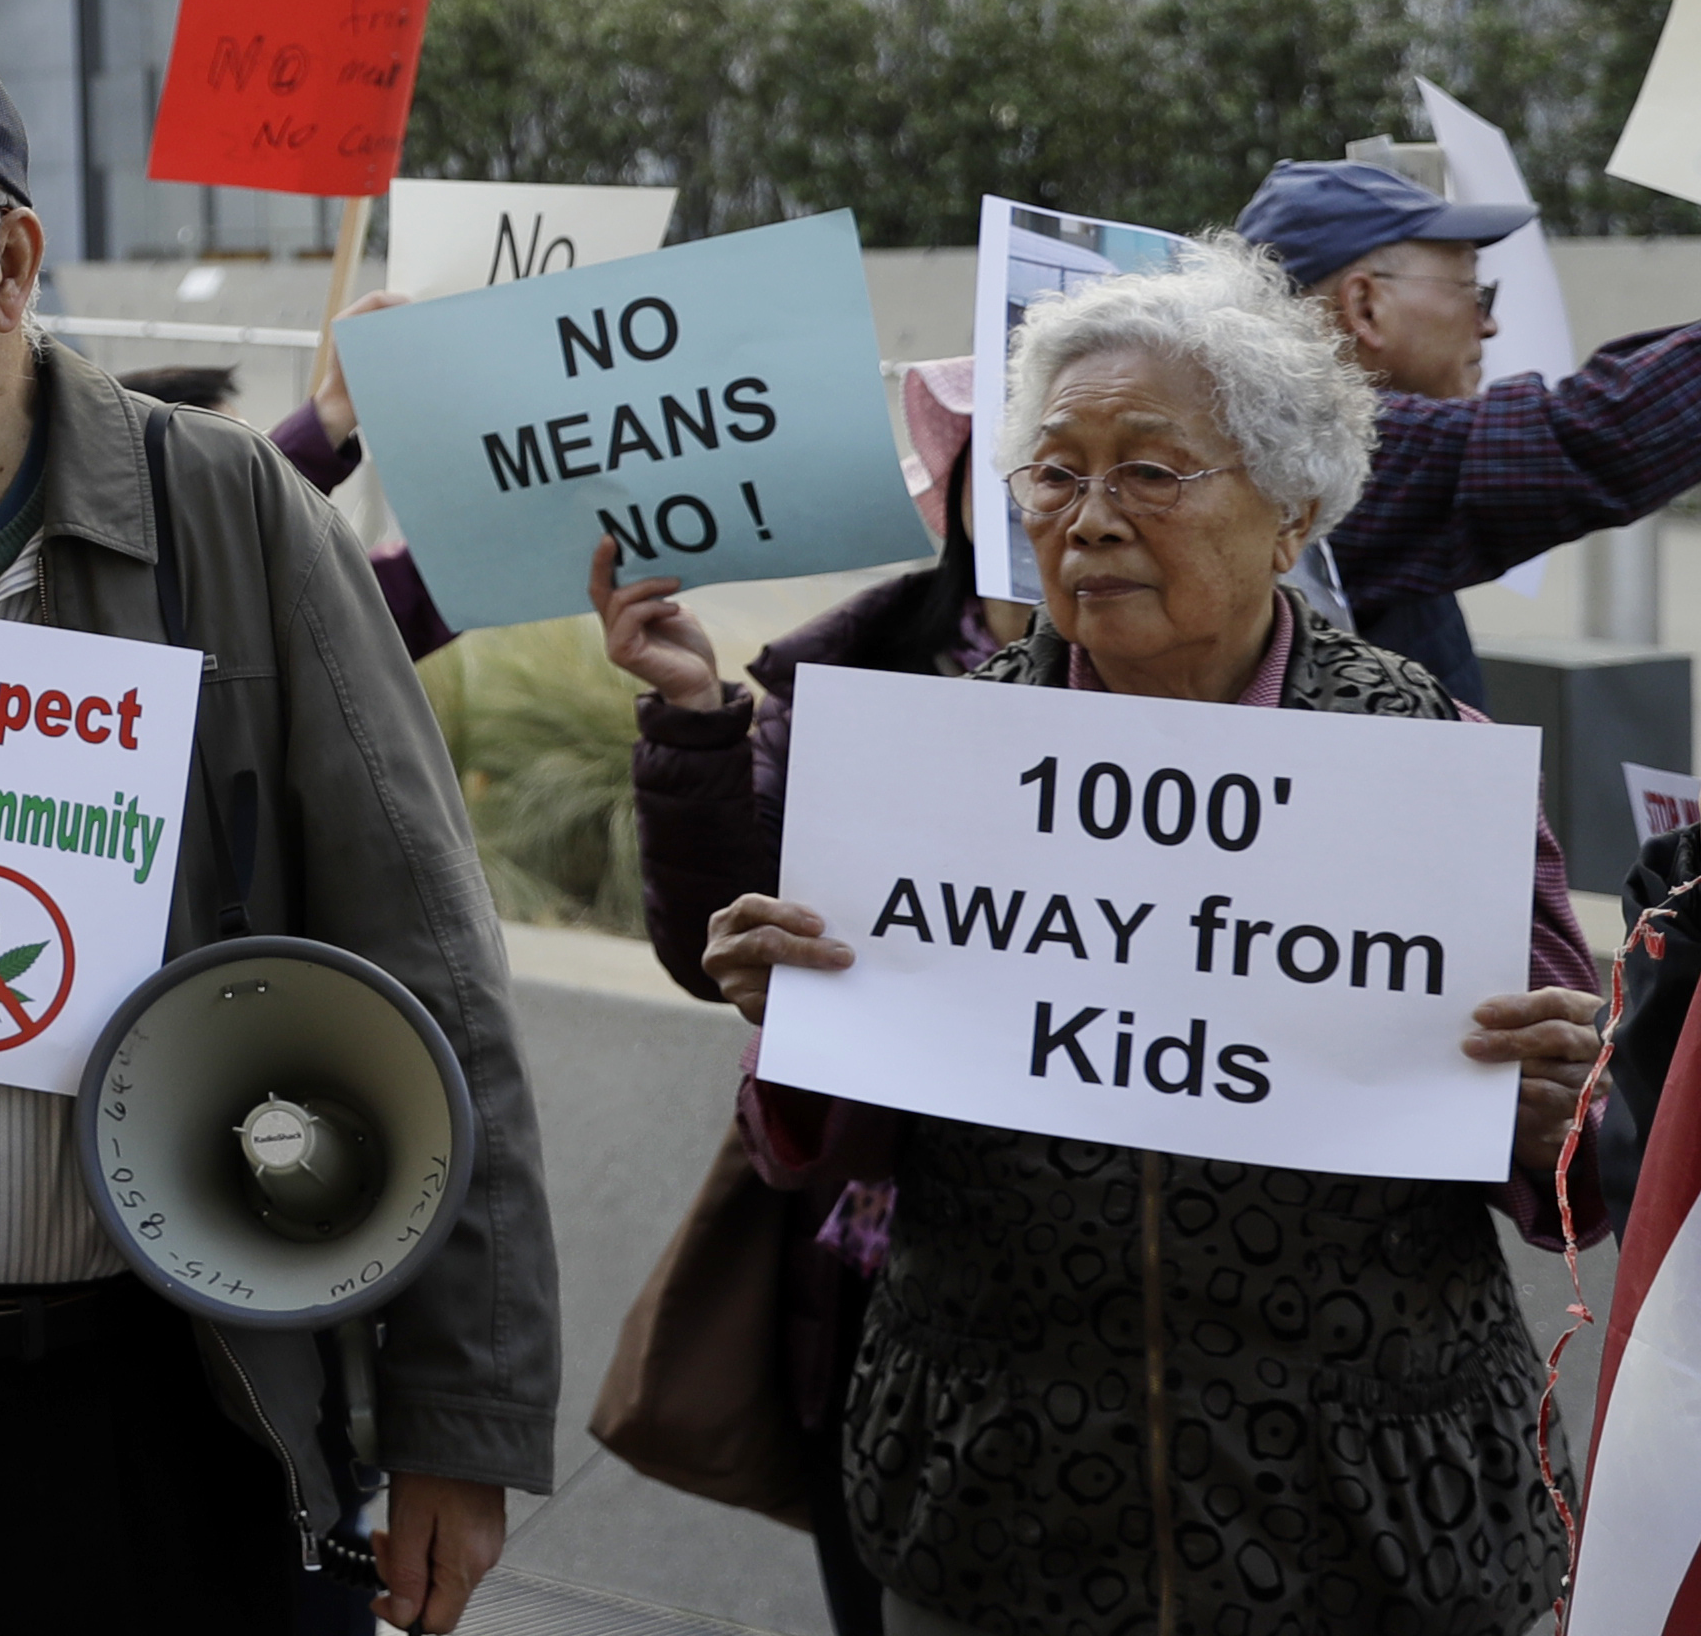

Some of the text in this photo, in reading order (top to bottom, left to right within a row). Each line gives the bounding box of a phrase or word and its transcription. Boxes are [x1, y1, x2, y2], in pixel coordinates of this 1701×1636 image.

[556, 296, 679, 378] NO
[481, 376, 777, 493] MEANS
[1019, 755, 1293, 853] 1000'
[870, 877, 1445, 997] AWAY from
[1028, 1001, 1271, 1104] Kids
